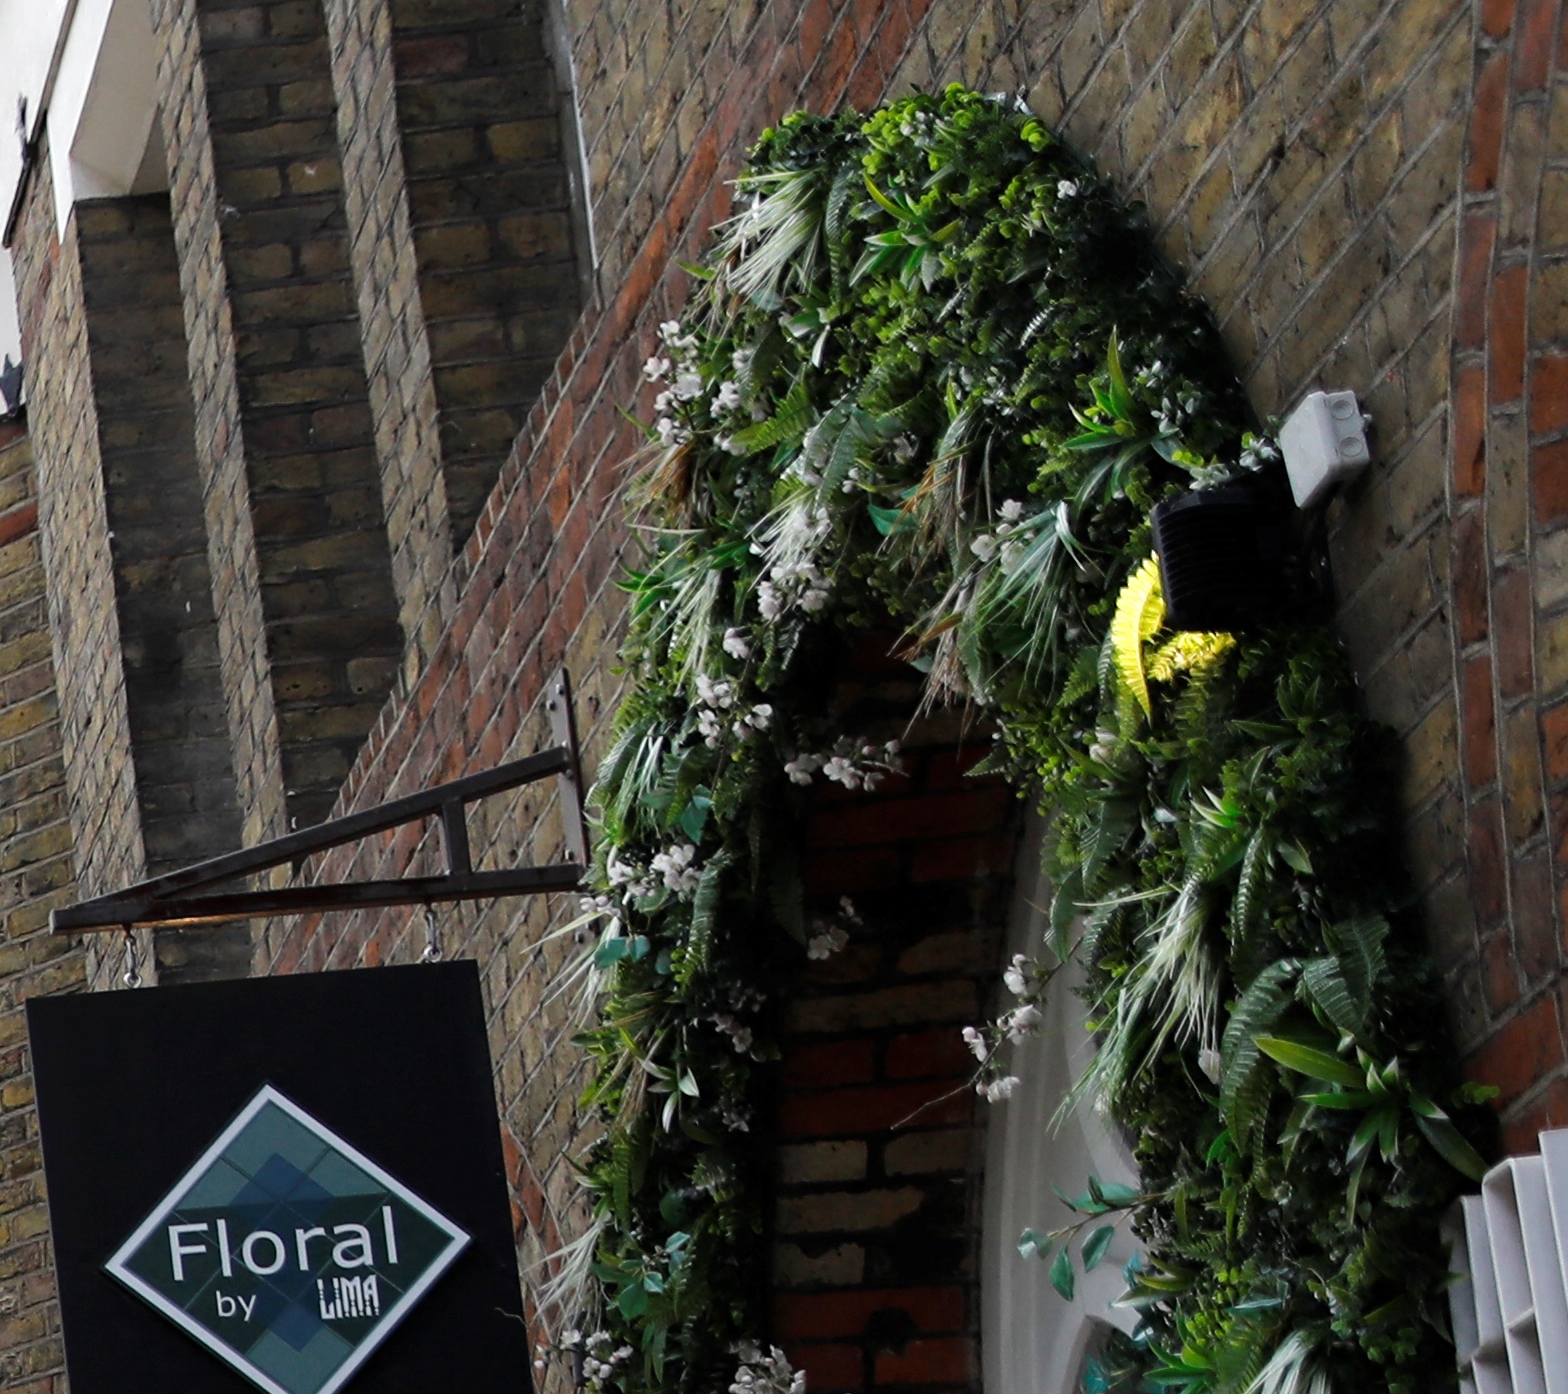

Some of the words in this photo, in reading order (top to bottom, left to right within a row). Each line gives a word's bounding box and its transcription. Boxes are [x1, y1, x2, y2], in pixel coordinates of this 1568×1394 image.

[168, 1205, 398, 1281] Floral
[215, 1290, 256, 1322] by
[317, 1274, 380, 1320] LIMA
